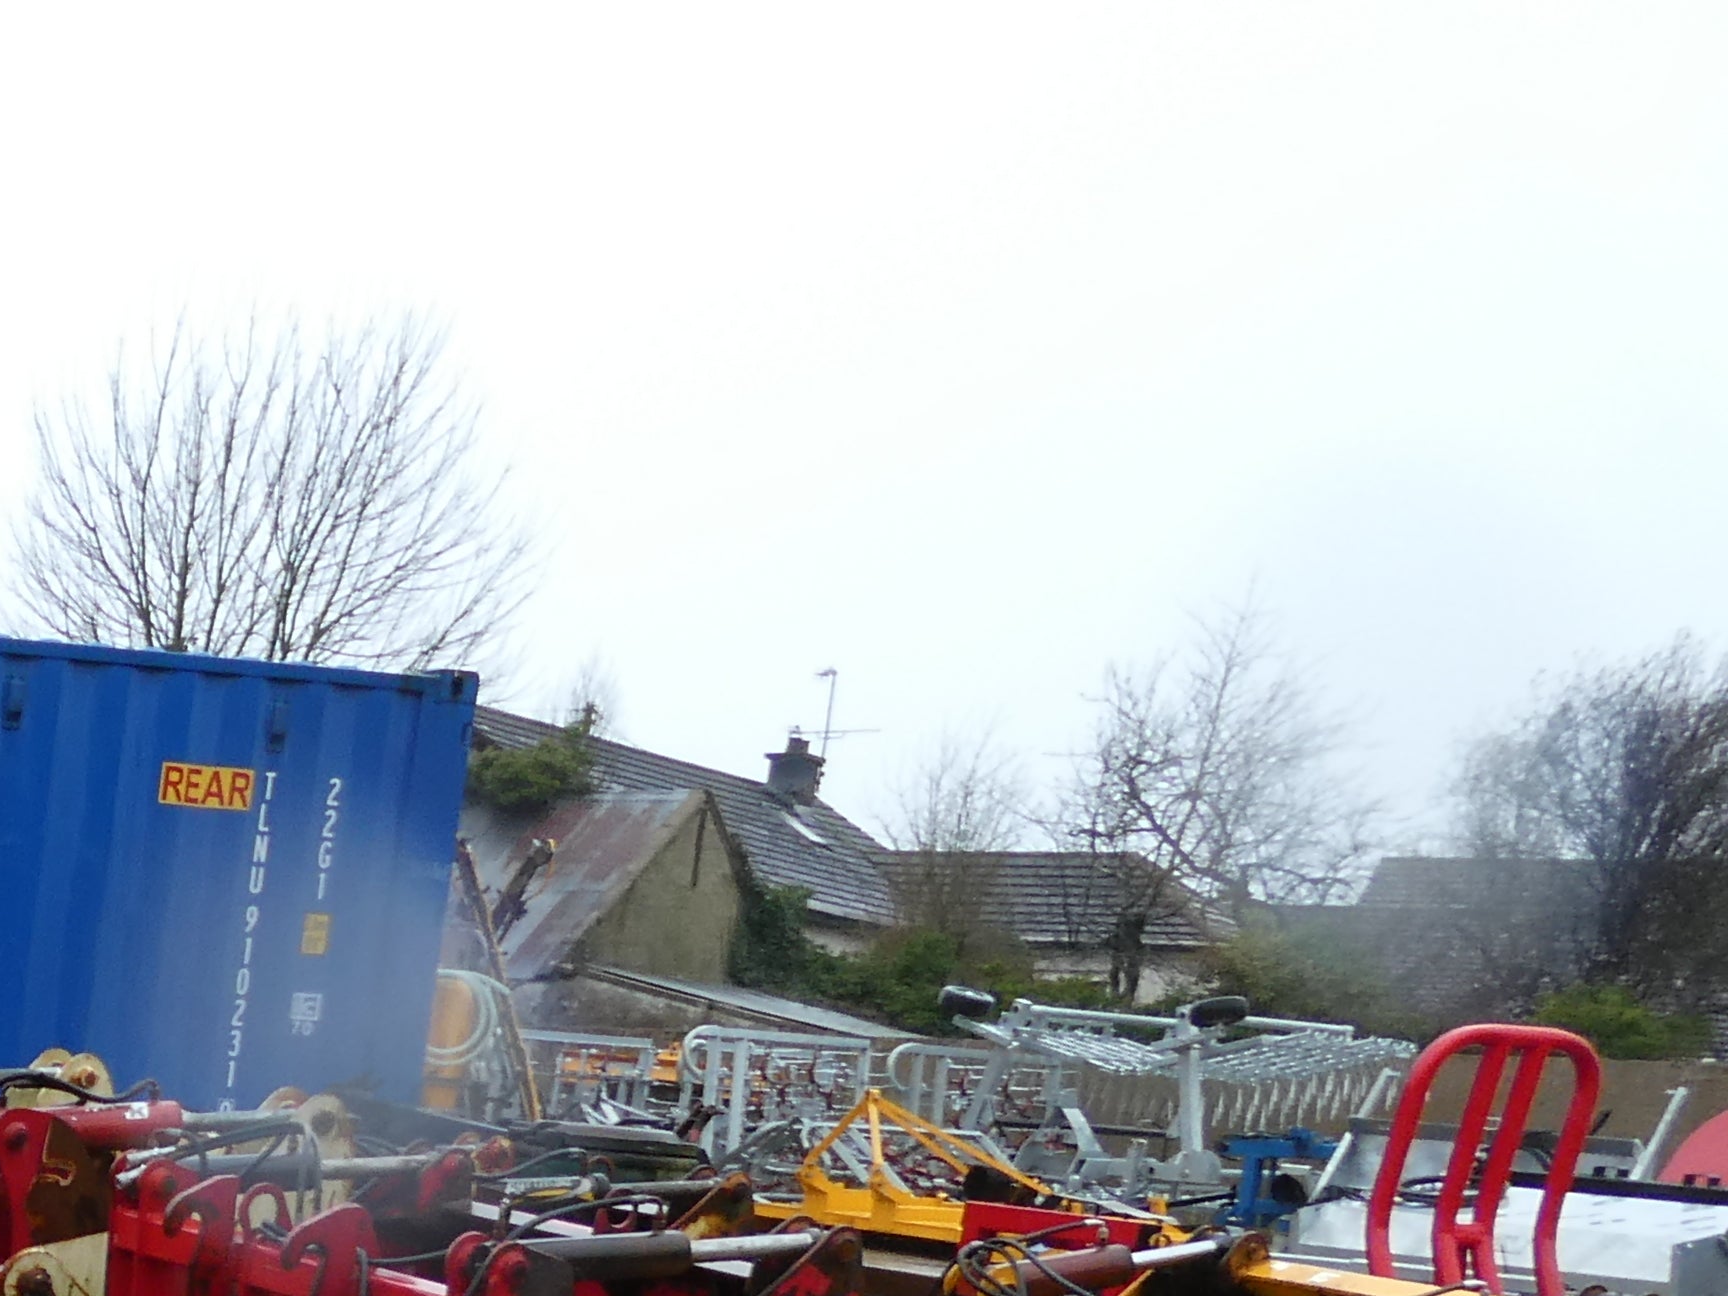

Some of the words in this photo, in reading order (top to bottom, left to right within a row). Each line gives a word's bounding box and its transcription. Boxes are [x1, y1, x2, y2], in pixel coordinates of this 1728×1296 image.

[162, 764, 251, 808] REAR
[248, 771, 277, 894] TLNU
[317, 777, 342, 900] 22G1
[226, 905, 259, 1088] 910231
